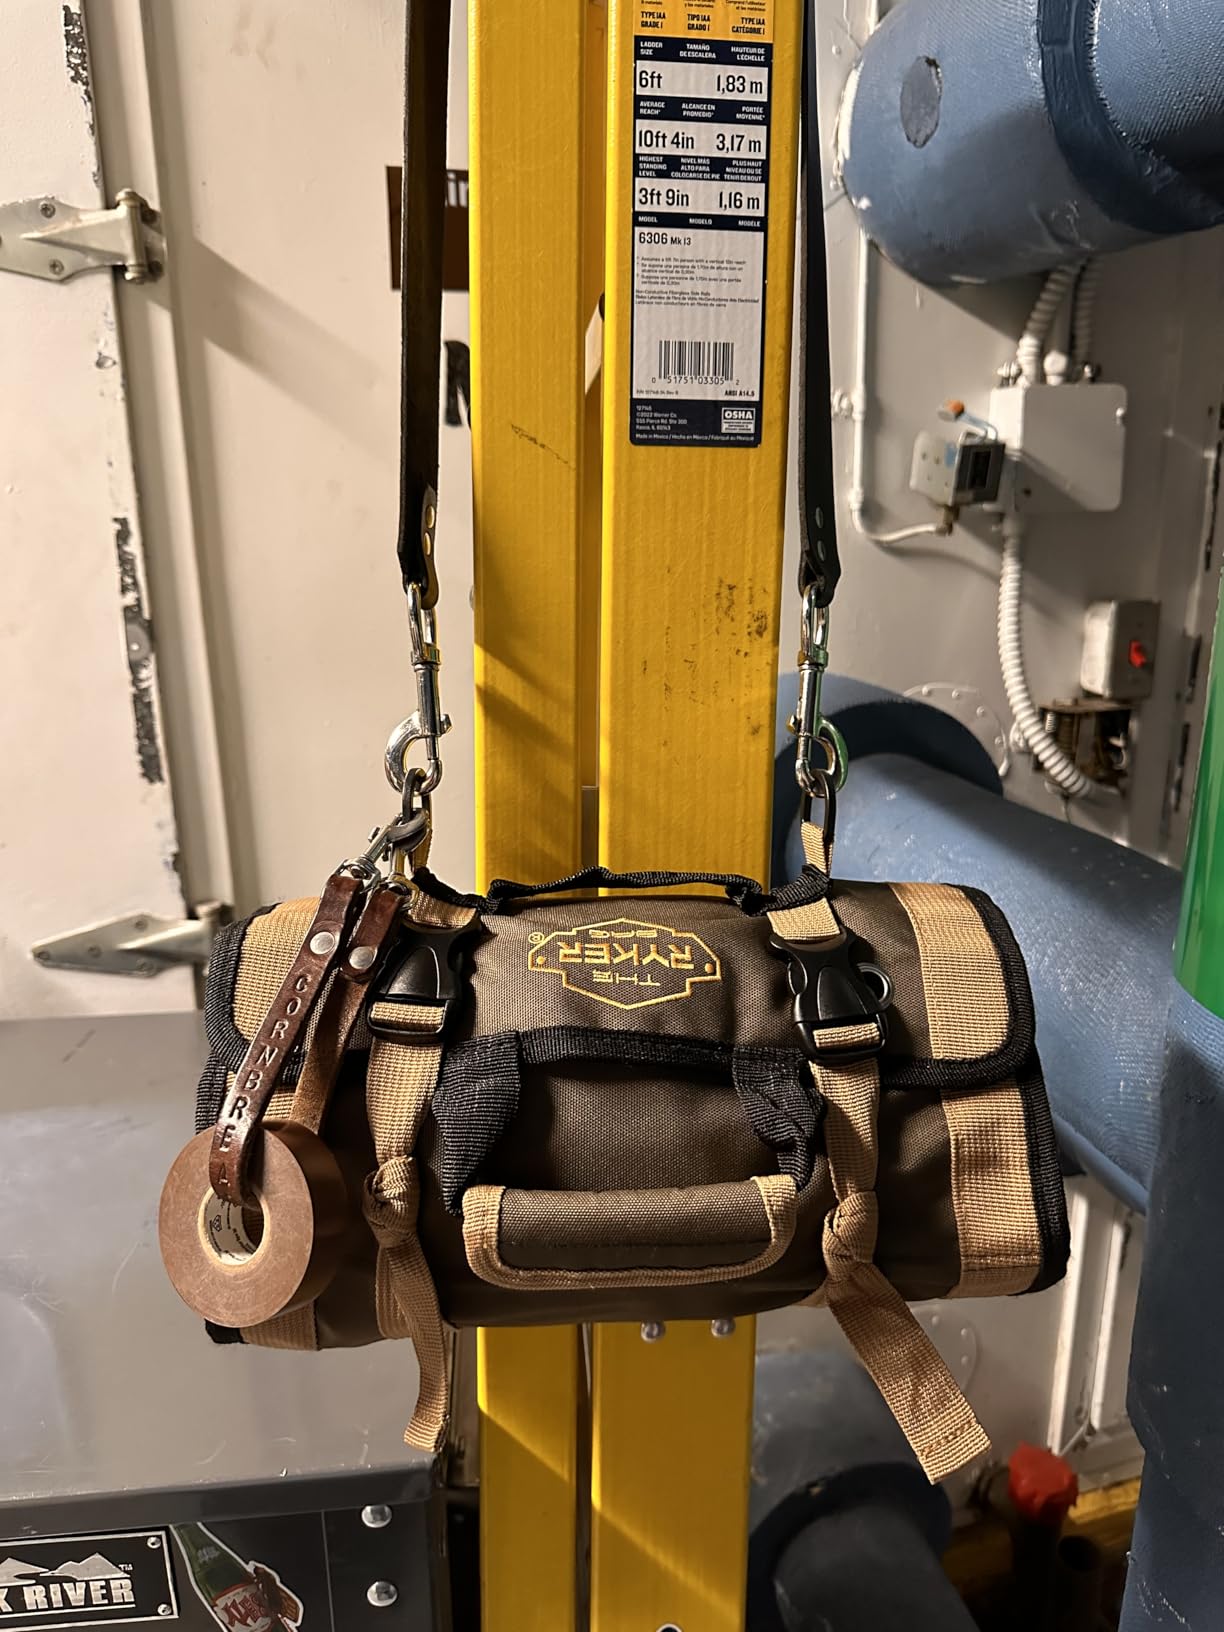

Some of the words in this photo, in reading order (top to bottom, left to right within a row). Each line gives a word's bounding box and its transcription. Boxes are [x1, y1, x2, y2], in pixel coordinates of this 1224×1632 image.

[641, 11, 655, 19] TYPE
[641, 20, 660, 28] GRADE
[741, 17, 755, 25] TYPE
[687, 23, 707, 31] GRADO
[731, 46, 757, 54] HAUTEUR
[639, 70, 663, 89] 6ft
[716, 74, 746, 95] 1,83
[750, 80, 763, 94] m
[639, 129, 668, 149] 10ft
[671, 131, 695, 150] 4in
[716, 133, 745, 154] 3,17
[749, 140, 761, 153] m
[639, 187, 662, 206] 3ft
[665, 188, 690, 207] 9in
[719, 191, 743, 211] 1,16
[747, 196, 760, 210] m
[639, 232, 668, 245] 6306
[670, 236, 682, 246] Mk
[698, 377, 725, 385] 03305
[724, 410, 753, 419] OSHA
[557, 941, 695, 970] RYKER
[592, 969, 660, 987] THE
[23, 1578, 136, 1610] RIVER
